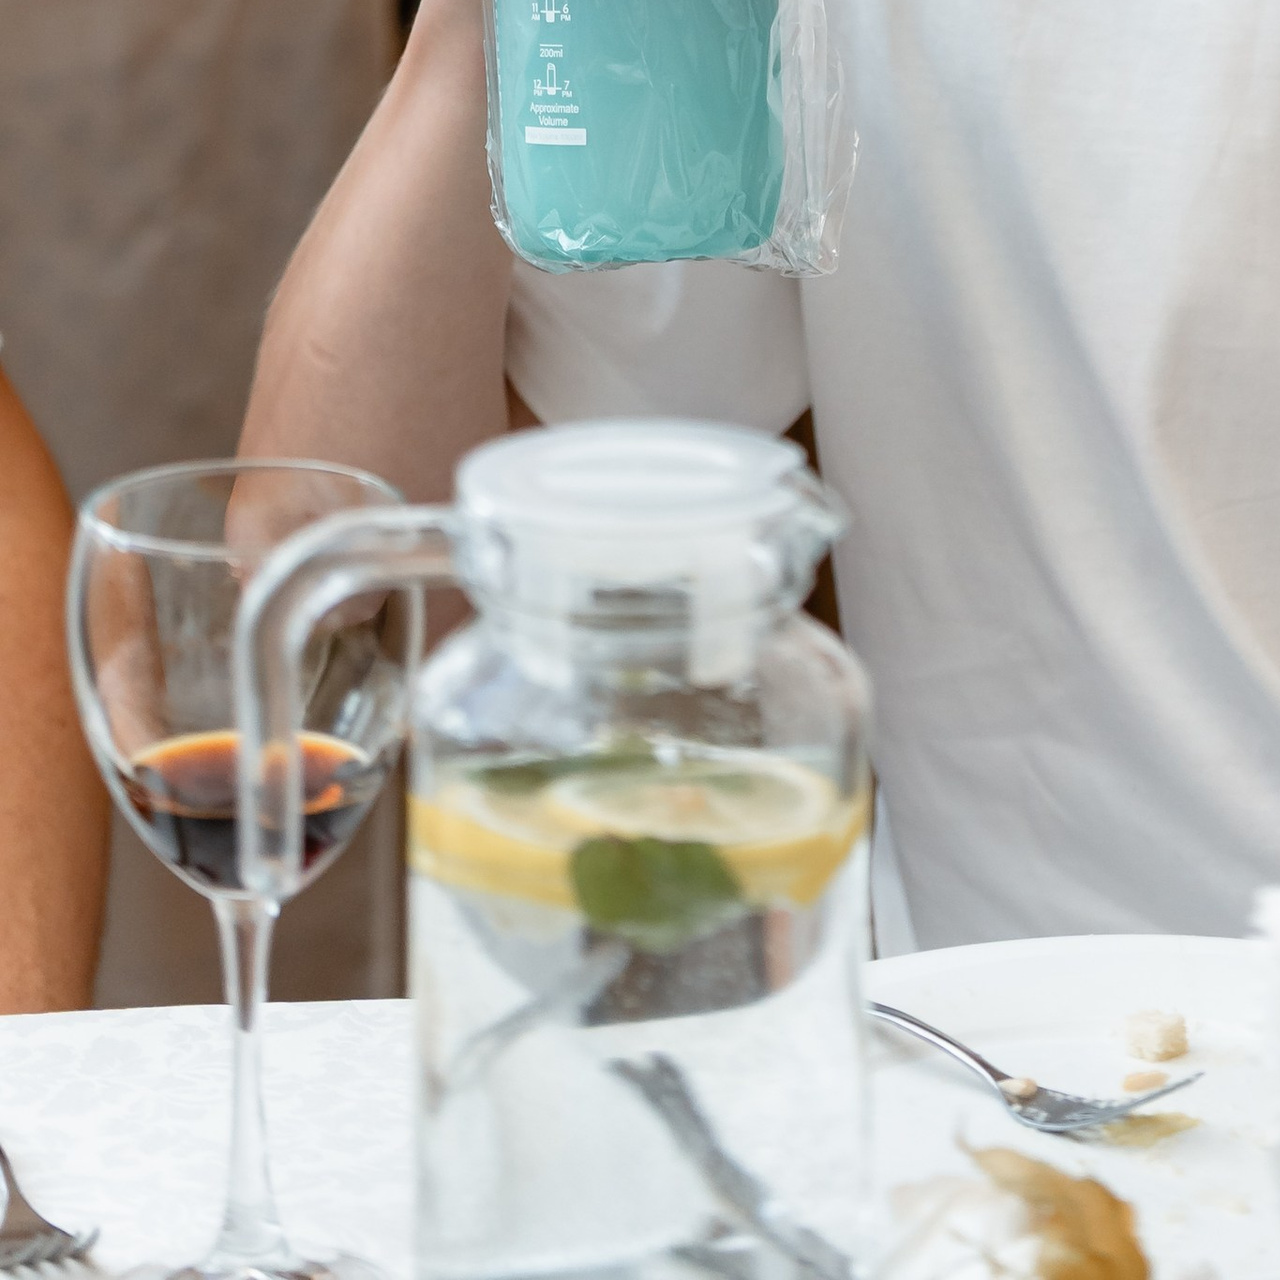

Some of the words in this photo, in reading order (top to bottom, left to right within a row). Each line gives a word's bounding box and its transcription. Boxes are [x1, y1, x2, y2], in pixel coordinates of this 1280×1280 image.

[532, 2, 539, 13] 11
[562, 3, 569, 14] 6
[560, 14, 571, 22] PM
[539, 48, 563, 58] 200ml
[533, 79, 542, 89] 12
[563, 80, 570, 91] 7
[561, 90, 573, 98] PM
[530, 102, 580, 115] Approximate
[538, 115, 569, 127] Volume
